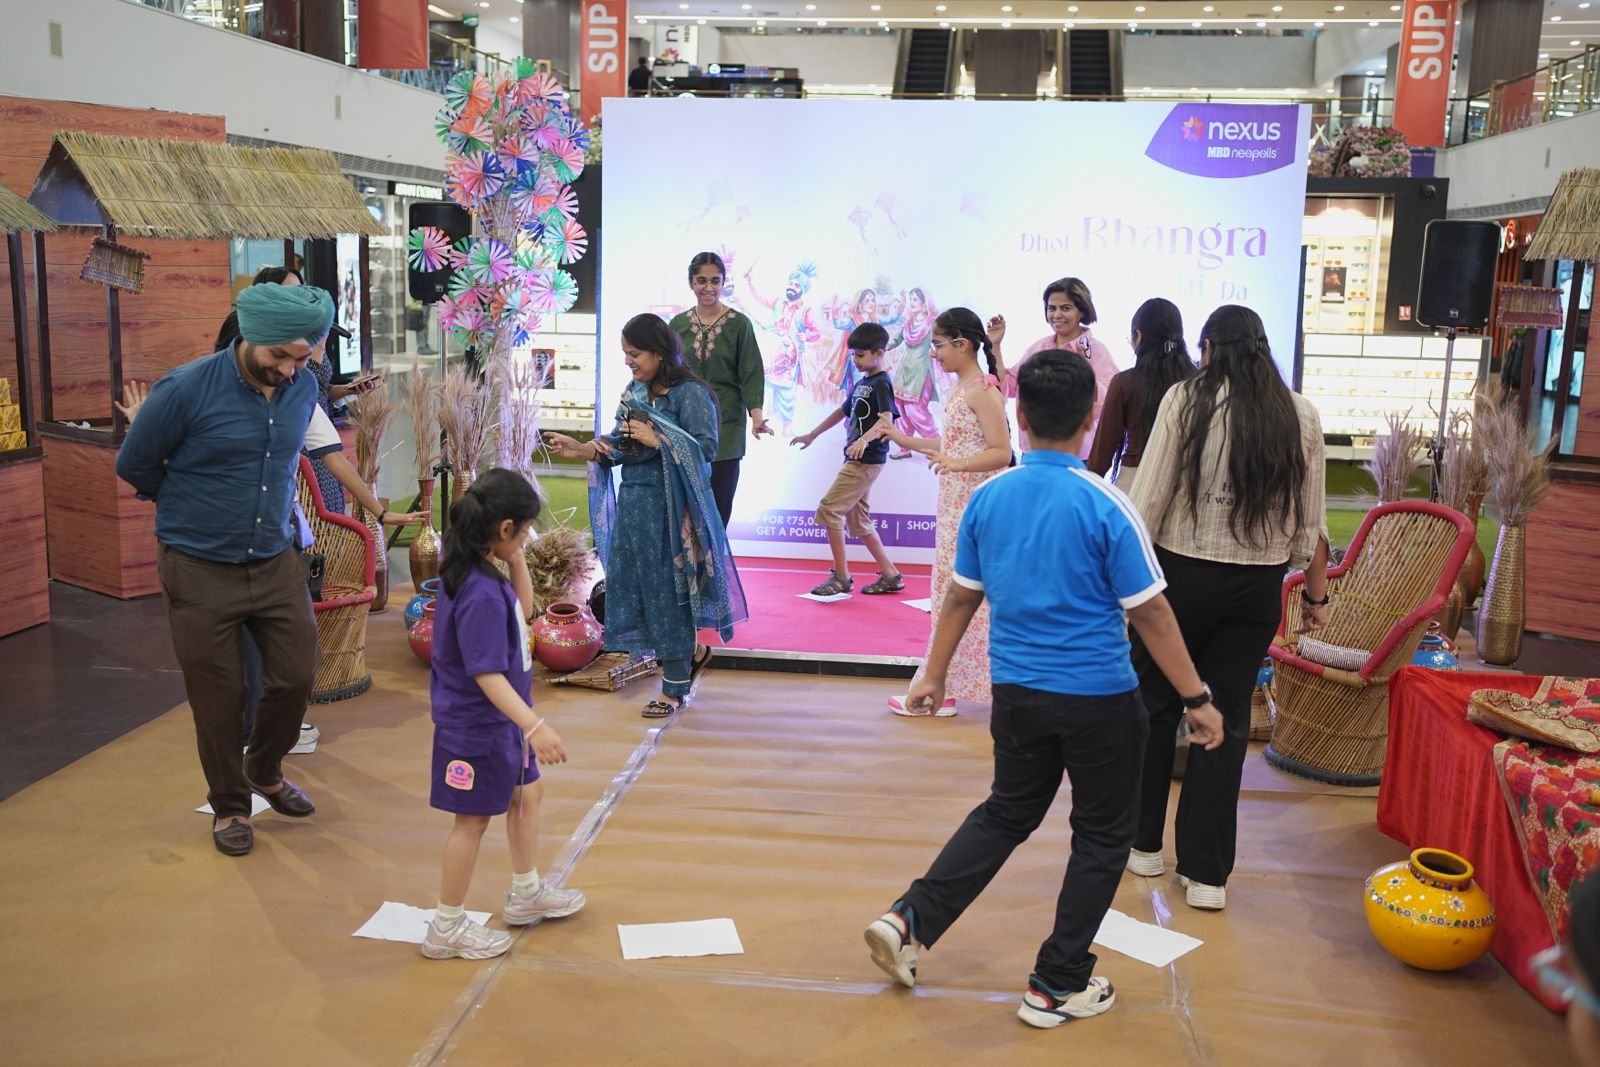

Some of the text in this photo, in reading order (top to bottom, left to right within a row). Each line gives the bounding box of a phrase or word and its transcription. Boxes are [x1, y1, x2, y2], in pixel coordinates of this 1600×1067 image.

[588, 3, 618, 74] SUP
[1407, 0, 1447, 80] SUP
[1207, 121, 1281, 140] nexus
[1207, 146, 1277, 162] MBD neopolis
[1082, 215, 1267, 271] Bhangra
[1219, 281, 1249, 301] Da
[762, 514, 784, 525] FOR
[880, 519, 889, 529] &
[907, 520, 936, 531] SHOP
[756, 526, 777, 536] GET
[778, 527, 787, 537] A
